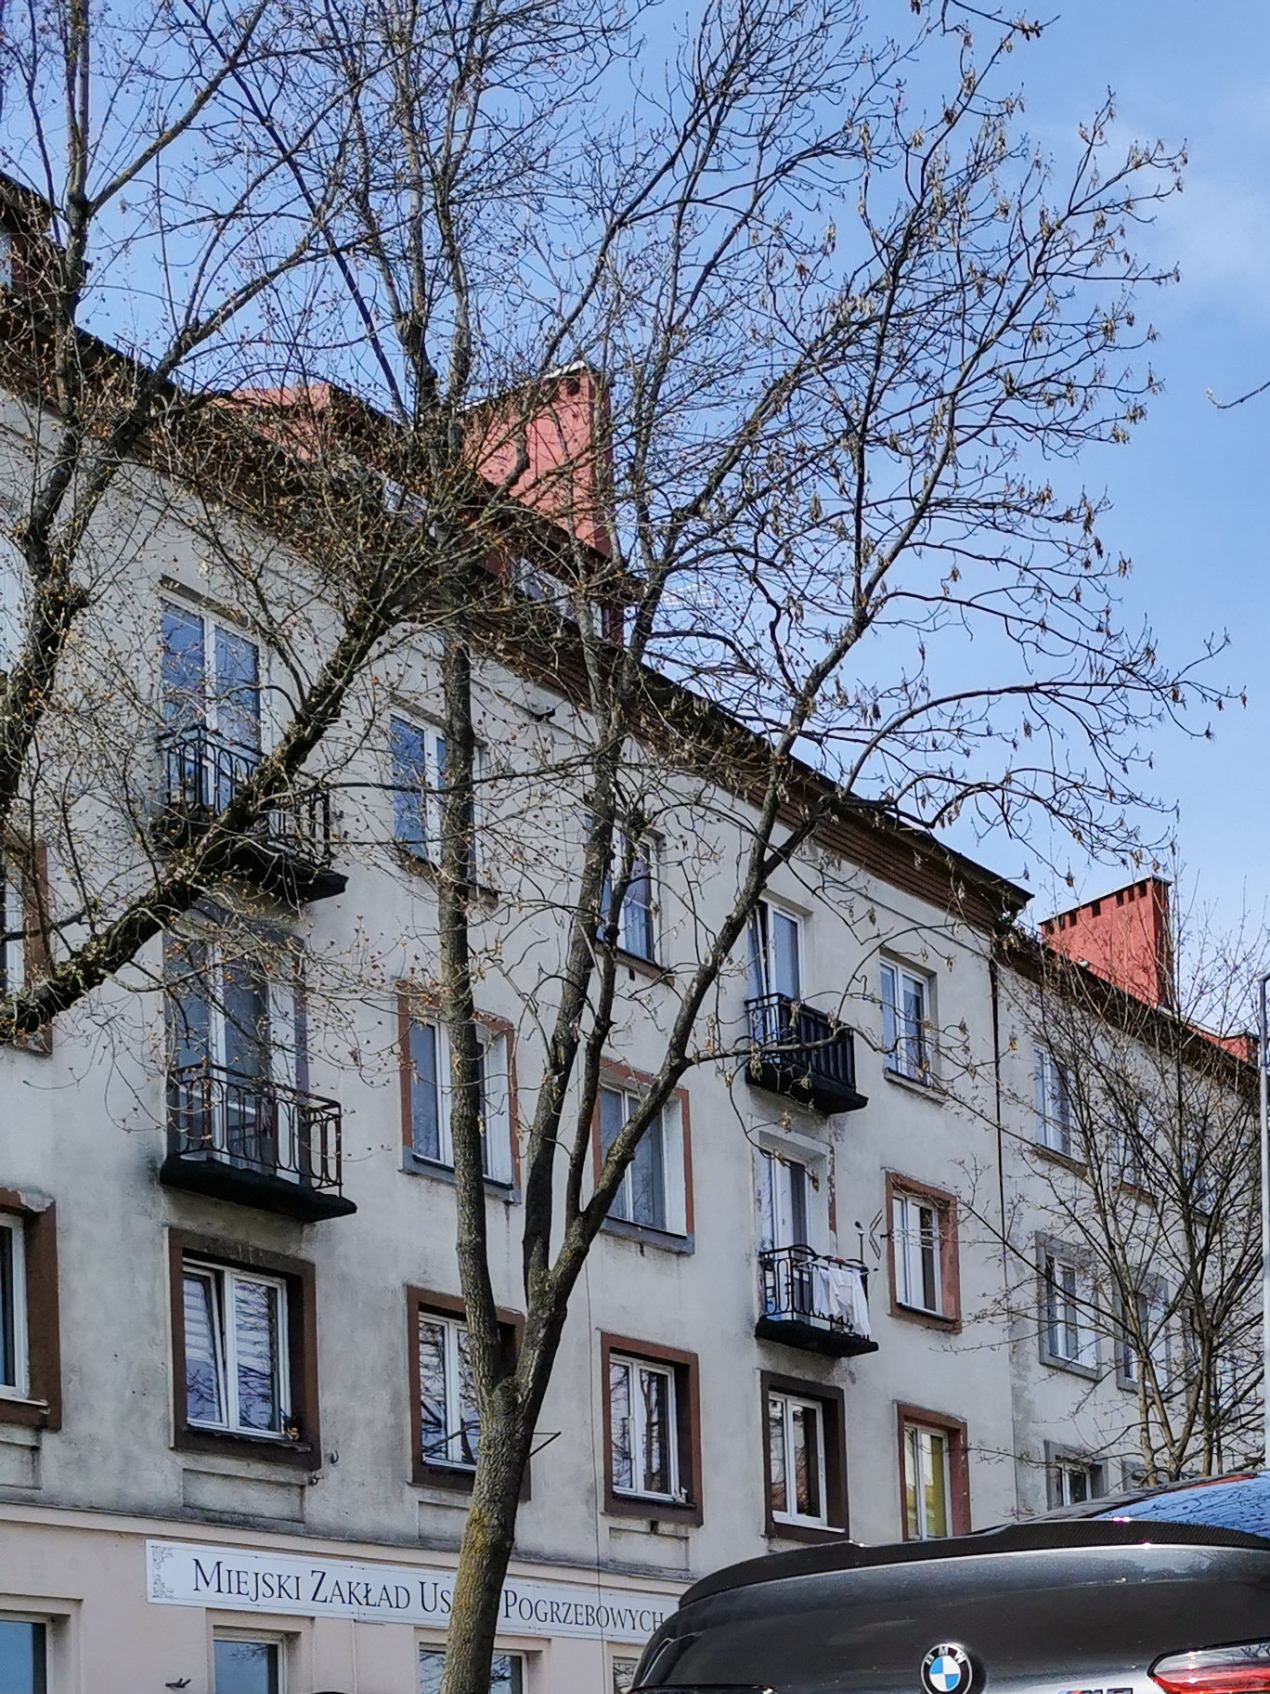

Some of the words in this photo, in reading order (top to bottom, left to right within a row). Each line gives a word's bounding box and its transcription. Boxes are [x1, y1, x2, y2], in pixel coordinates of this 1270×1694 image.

[192, 1557, 302, 1602] MIEJSKI
[309, 1569, 412, 1610] ZAKŁAD
[502, 1589, 665, 1633] POGRZEBOWYCH
[924, 1645, 966, 1666] BMW
